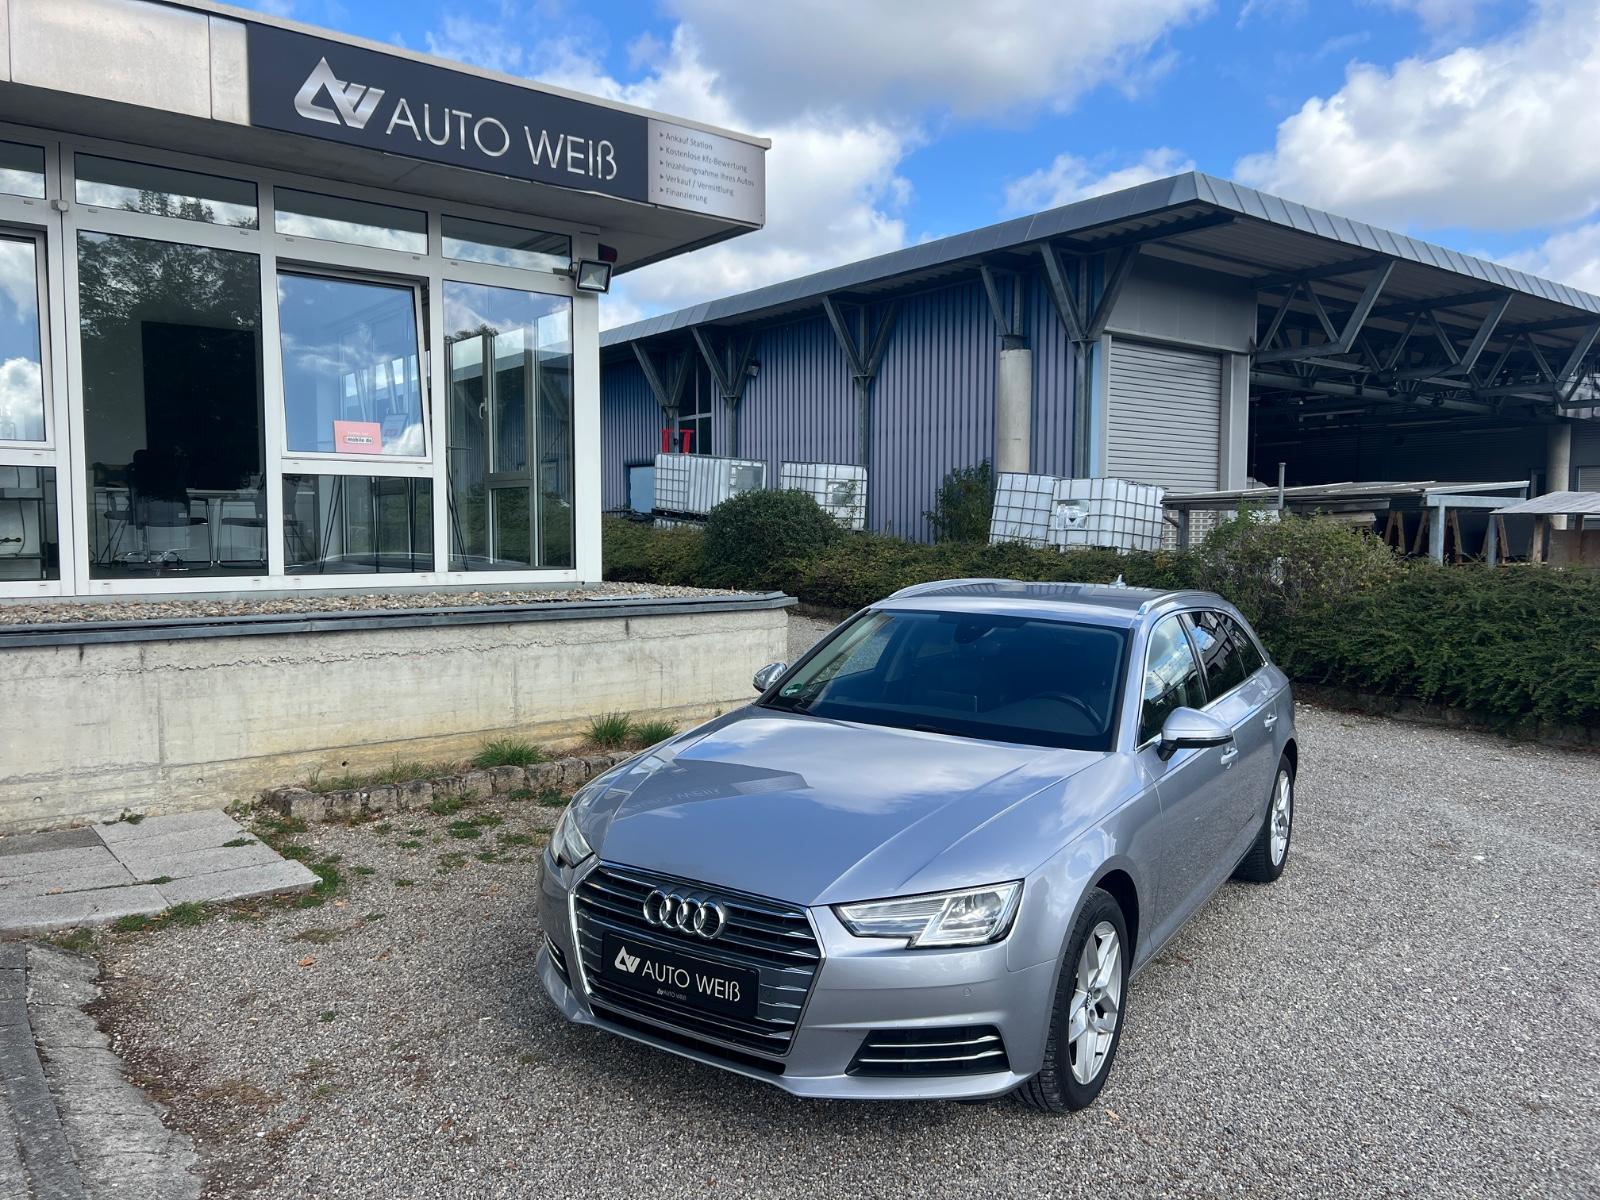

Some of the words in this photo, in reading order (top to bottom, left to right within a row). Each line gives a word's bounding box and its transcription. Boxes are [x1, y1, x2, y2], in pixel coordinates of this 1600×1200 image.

[385, 97, 511, 157] AUTO
[523, 125, 618, 181] WEIß
[665, 133, 689, 144] Ankauf
[690, 138, 713, 150] Station
[665, 147, 701, 161] Kostenlose
[665, 174, 691, 187] Verkauf
[697, 181, 734, 197] Vermittlung
[736, 176, 755, 187] Autos
[665, 187, 708, 204] Finanzierung
[641, 960, 690, 988] AUTO
[695, 973, 741, 1002] WEIß
